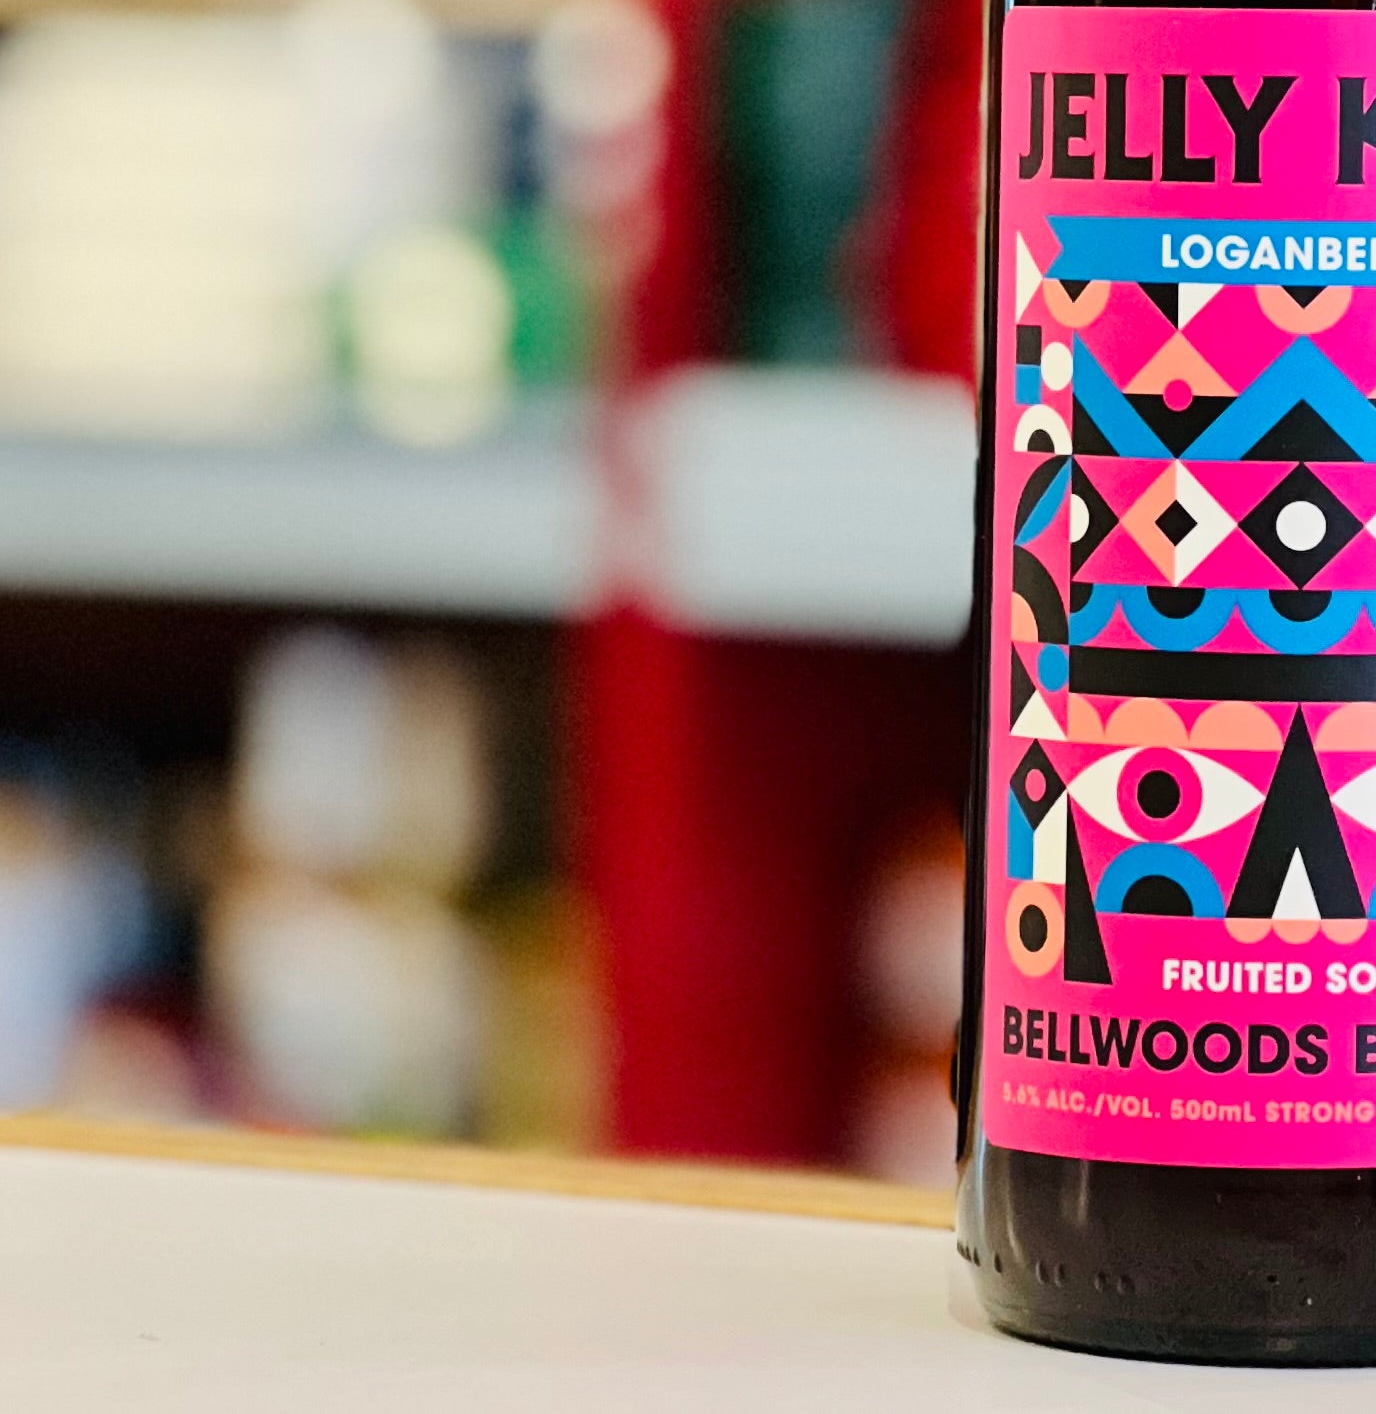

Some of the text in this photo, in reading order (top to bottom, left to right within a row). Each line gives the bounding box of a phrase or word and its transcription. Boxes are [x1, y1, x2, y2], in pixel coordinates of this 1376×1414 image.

[1018, 71, 1299, 185] JELLY
[1162, 958, 1312, 994] FRUITED
[1003, 1004, 1329, 1076] BELLWOODS
[1002, 1082, 1040, 1107] 5.6%
[1046, 1090, 1161, 1119] ALC./VOL.
[1170, 1098, 1256, 1123] 500mL
[1265, 1100, 1375, 1123] STRONG
